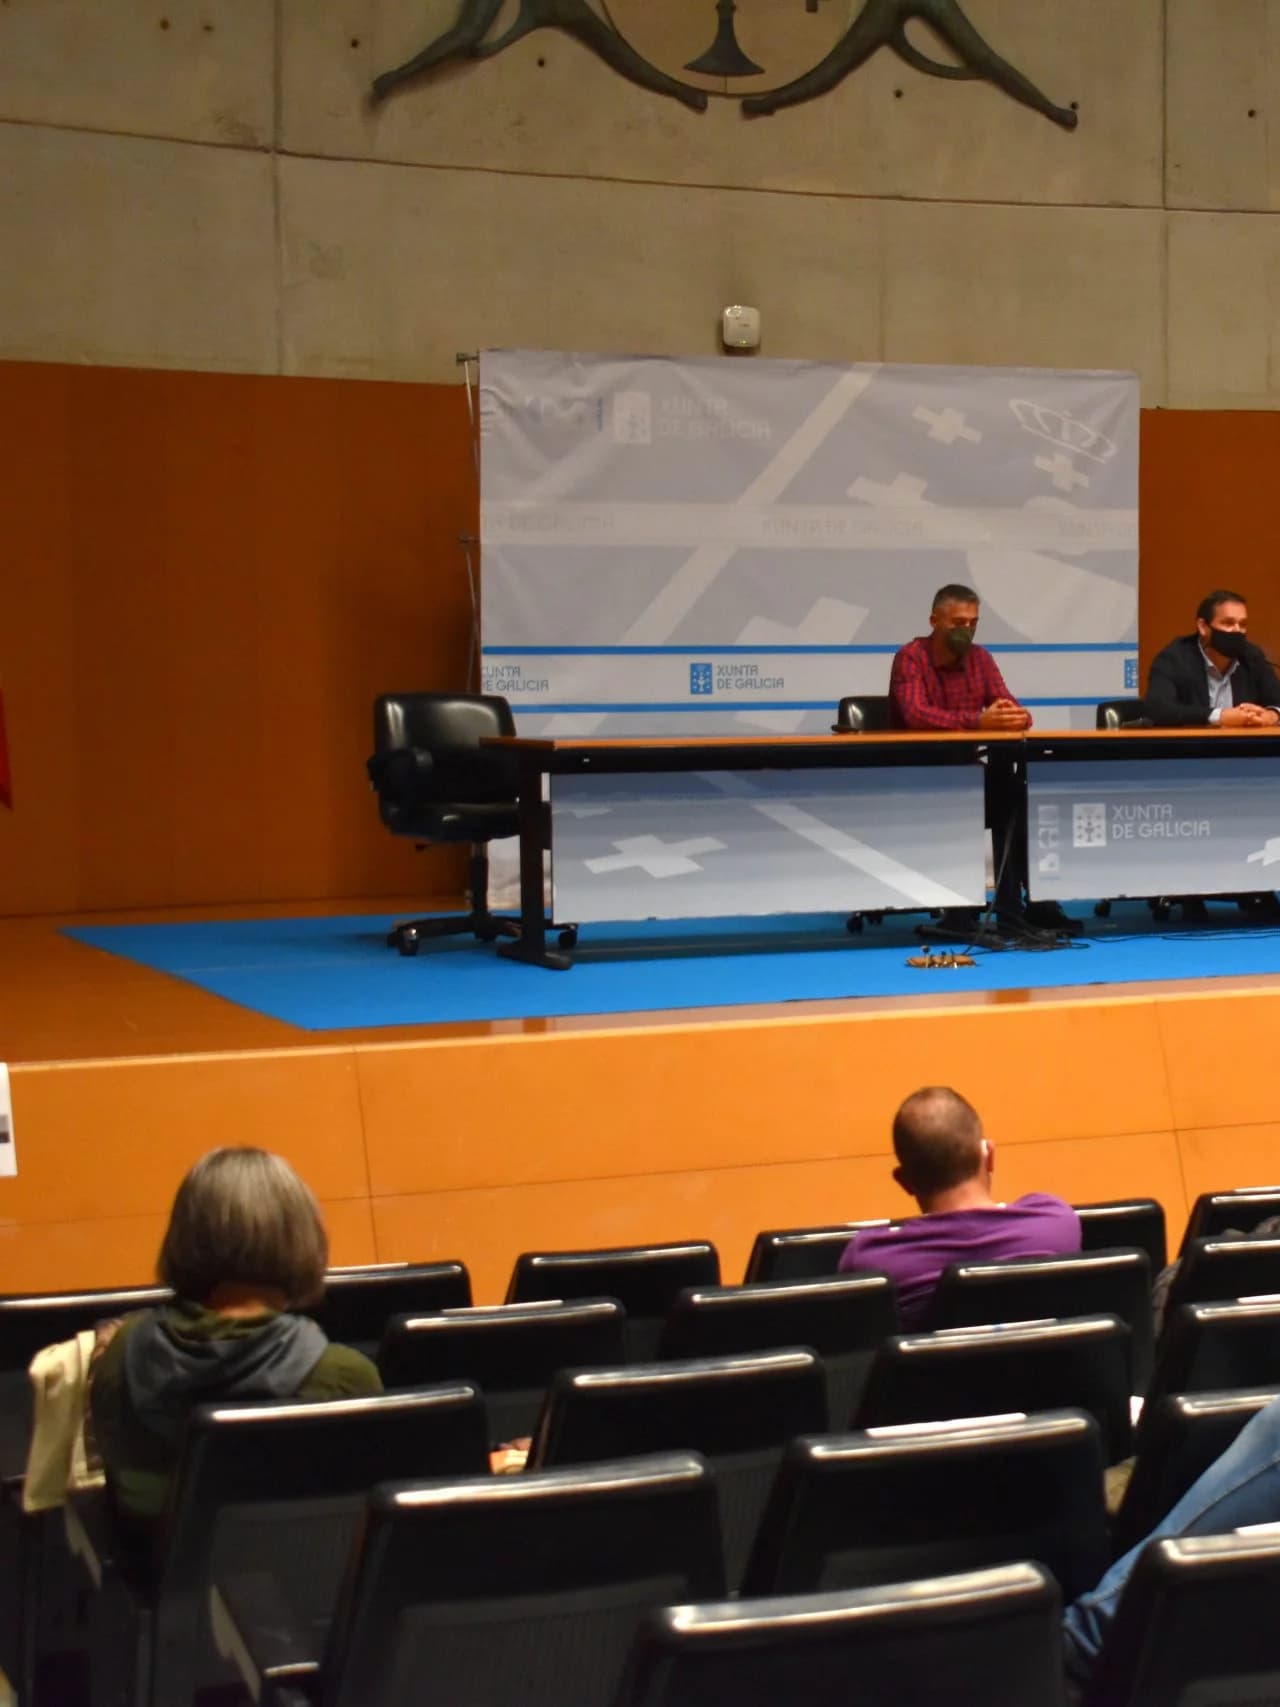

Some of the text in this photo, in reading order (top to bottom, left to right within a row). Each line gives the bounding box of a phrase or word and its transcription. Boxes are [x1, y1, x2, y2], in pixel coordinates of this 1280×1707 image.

[717, 664, 759, 677] XUNTA
[496, 679, 549, 692] GALICIA
[717, 677, 785, 690] DE GALICIA
[1111, 803, 1173, 822] XUNTA
[1112, 820, 1211, 840] DE GALICIA
